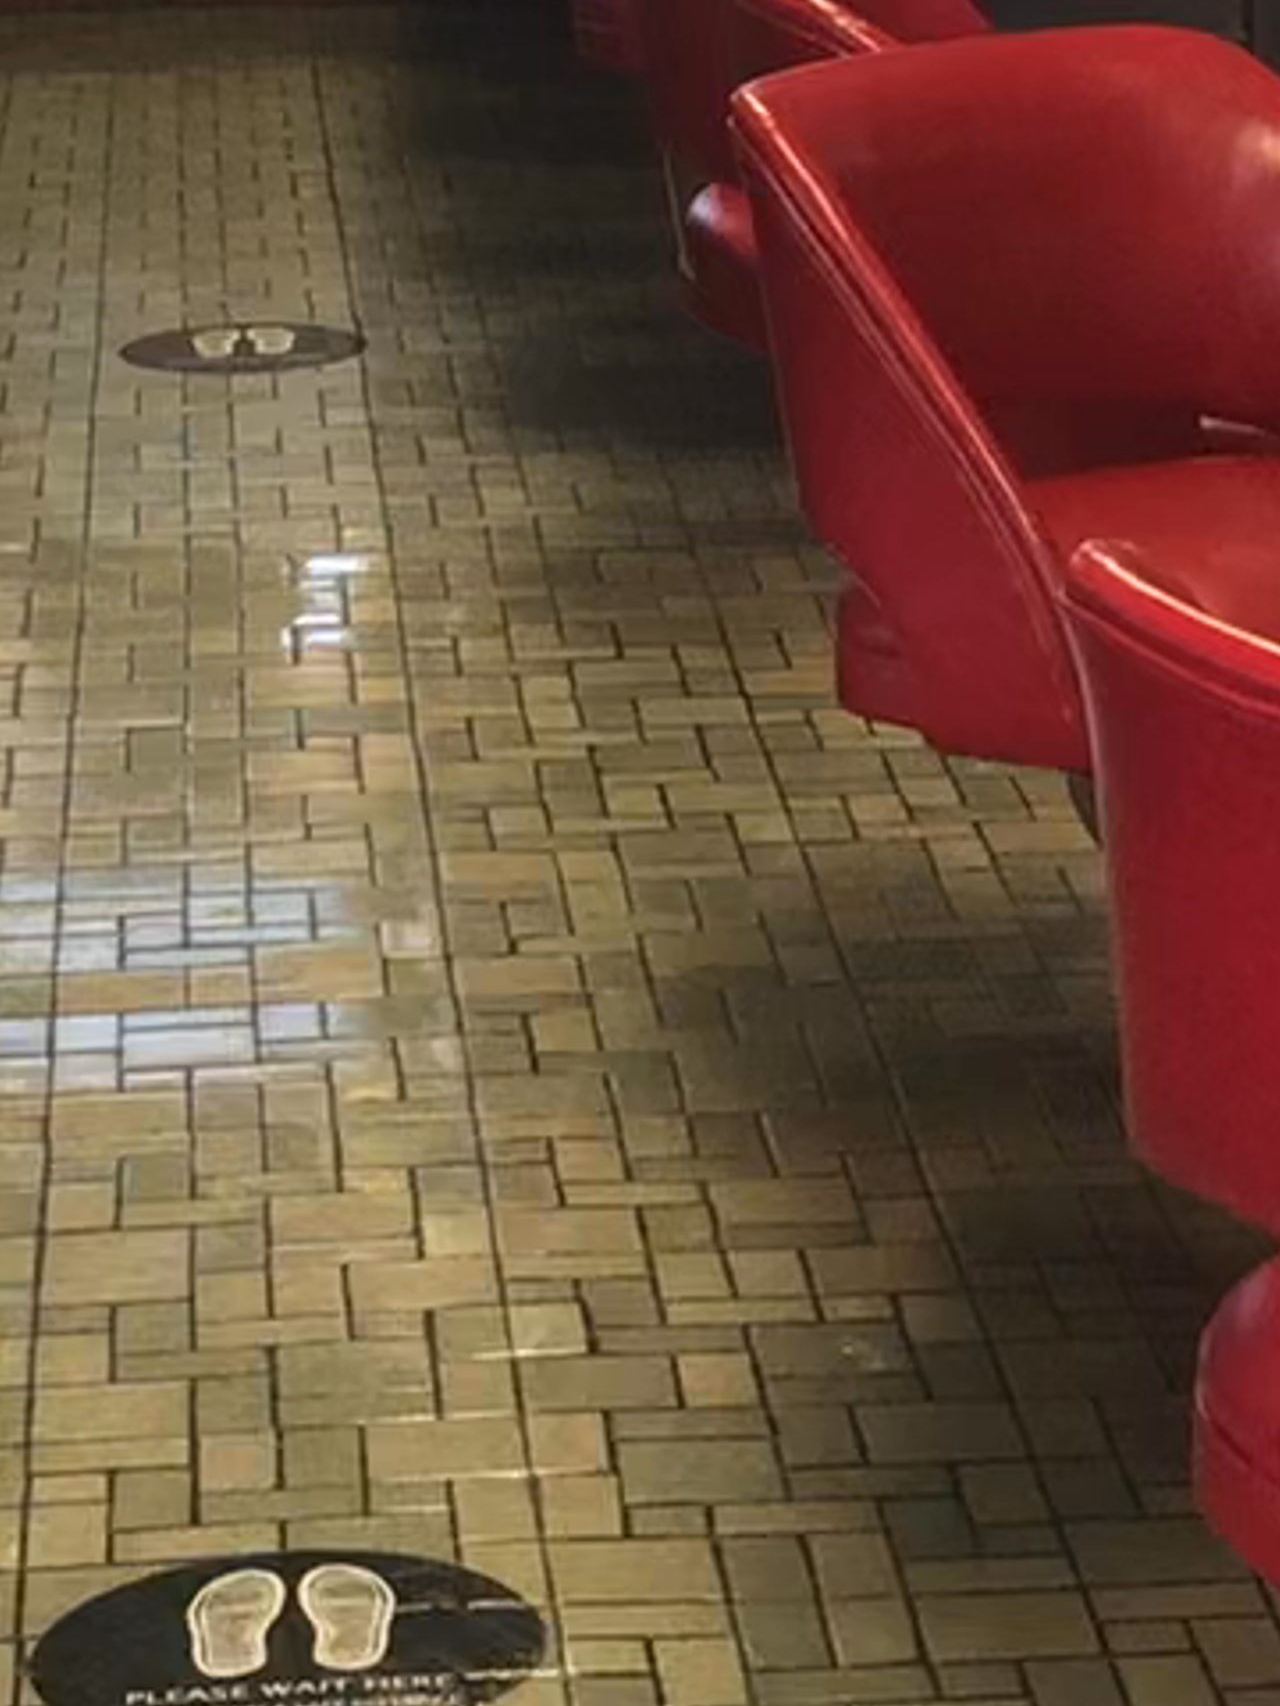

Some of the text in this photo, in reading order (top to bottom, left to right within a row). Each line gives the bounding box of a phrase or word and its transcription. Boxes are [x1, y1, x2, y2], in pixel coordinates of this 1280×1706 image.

[125, 1673, 458, 1706] PLEASE WAIT HERE
